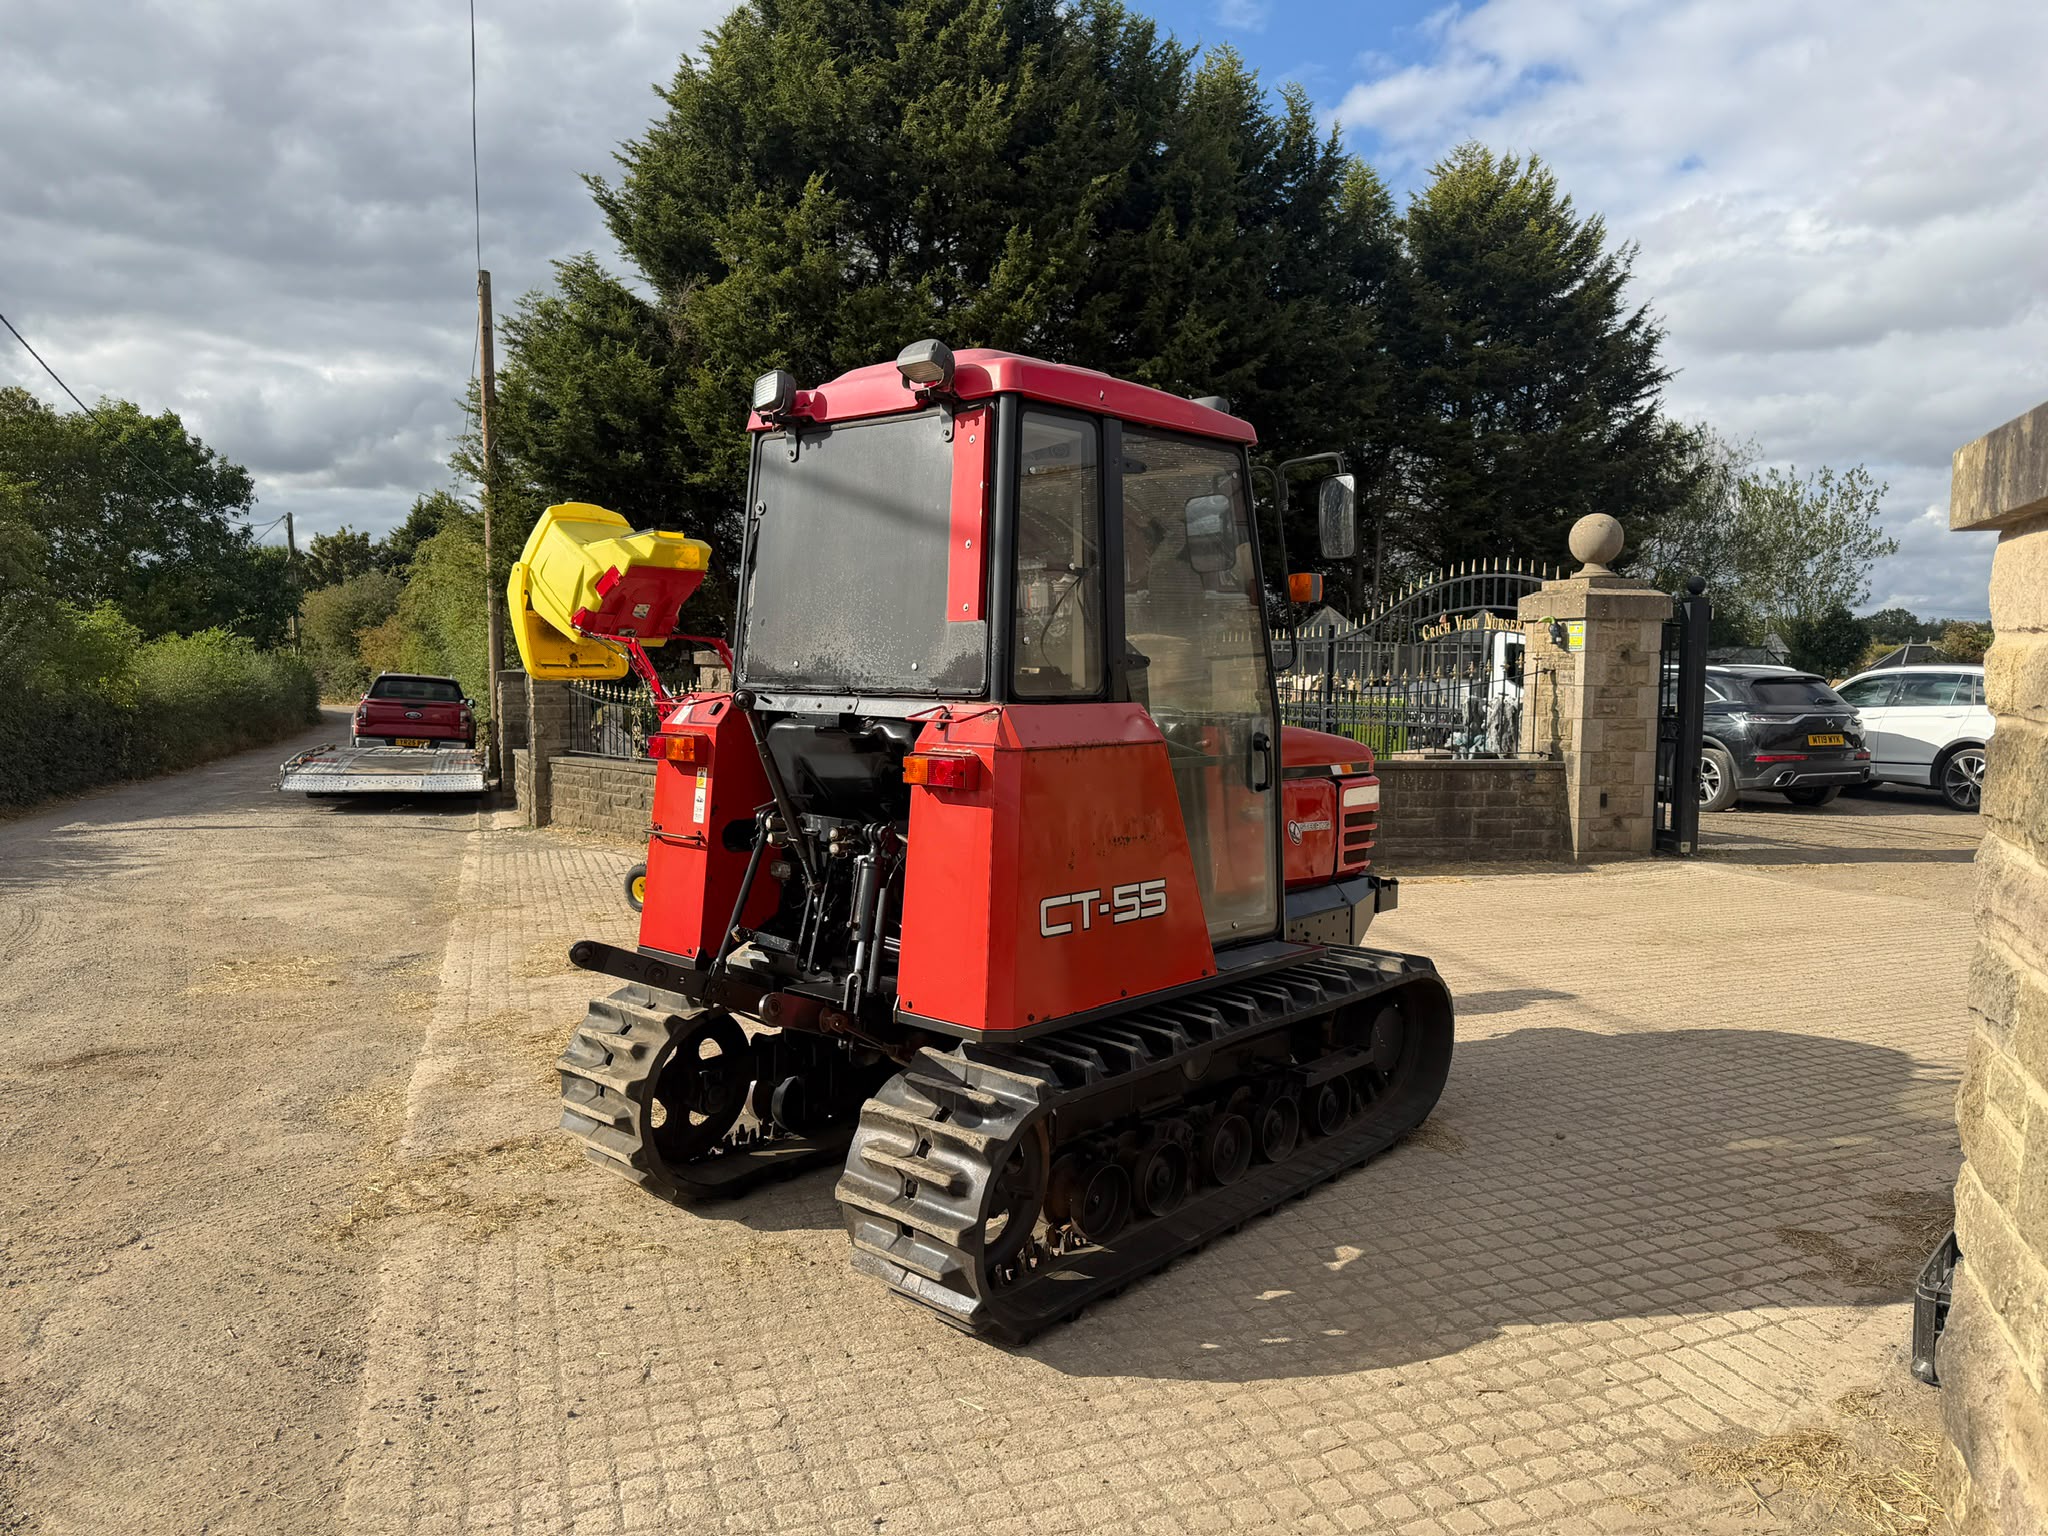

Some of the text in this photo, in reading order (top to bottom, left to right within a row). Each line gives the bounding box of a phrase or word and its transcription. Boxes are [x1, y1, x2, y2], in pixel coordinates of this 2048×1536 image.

[1422, 622, 1451, 641] CRICH
[1454, 614, 1479, 631] VIEW
[1040, 877, 1167, 938] CT-55
